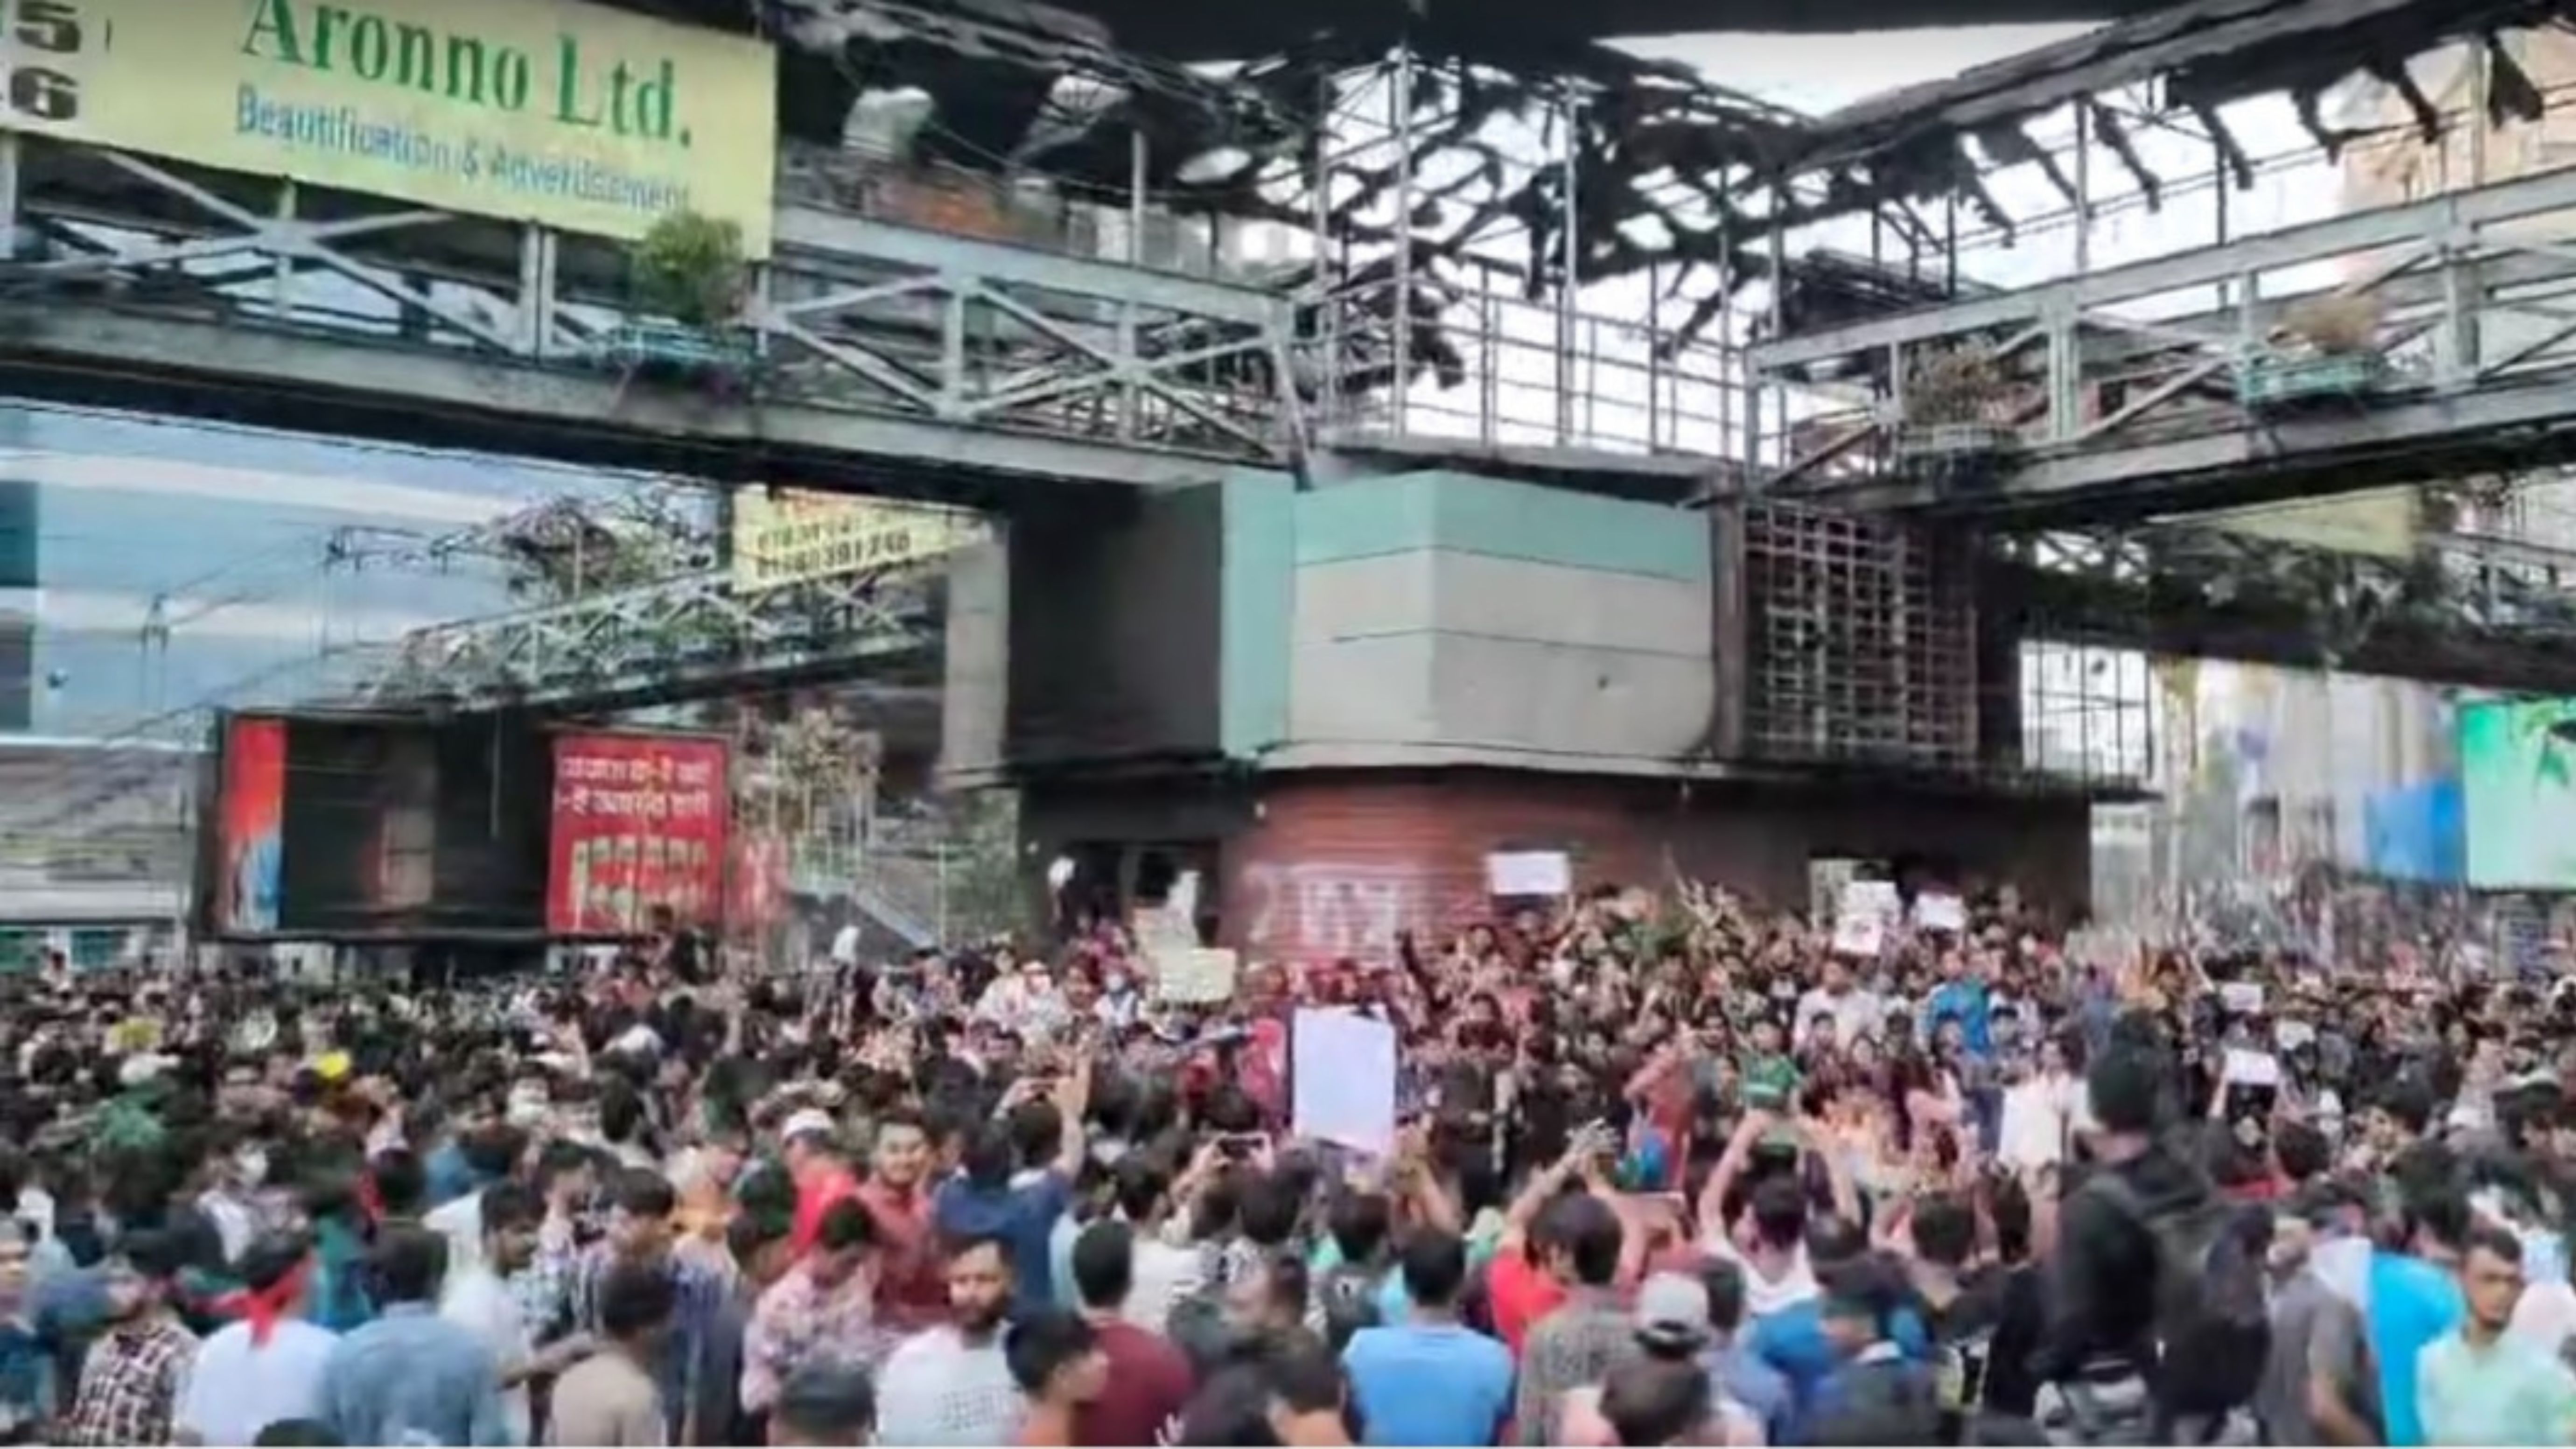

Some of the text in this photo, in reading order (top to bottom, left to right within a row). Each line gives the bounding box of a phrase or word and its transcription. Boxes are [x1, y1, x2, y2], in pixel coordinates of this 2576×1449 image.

[10, 67, 77, 120] 6
[241, 0, 693, 149] Aronno Ltd.
[238, 82, 456, 168] Beautification
